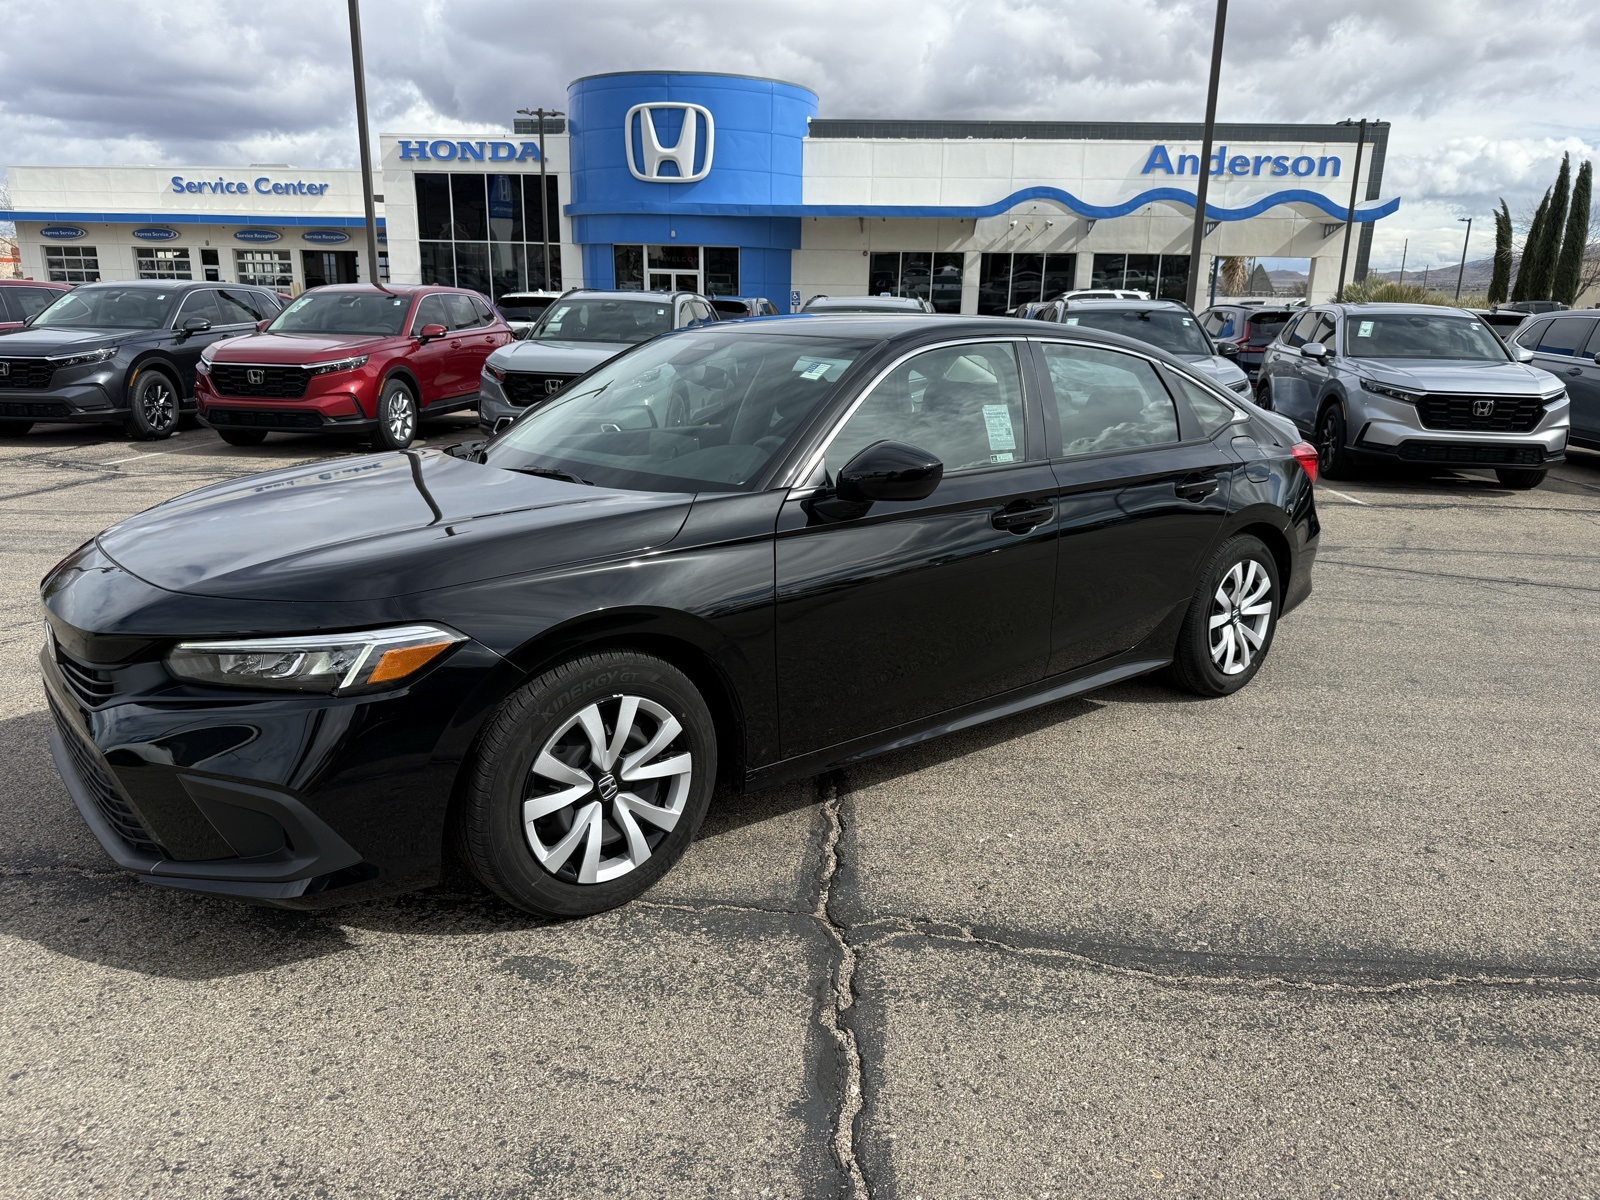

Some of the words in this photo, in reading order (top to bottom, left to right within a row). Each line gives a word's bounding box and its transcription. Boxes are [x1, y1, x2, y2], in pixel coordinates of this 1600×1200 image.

[397, 139, 548, 162] HONDA
[1140, 144, 1342, 177] Anderson
[171, 175, 249, 195] Service
[253, 176, 329, 196] Center
